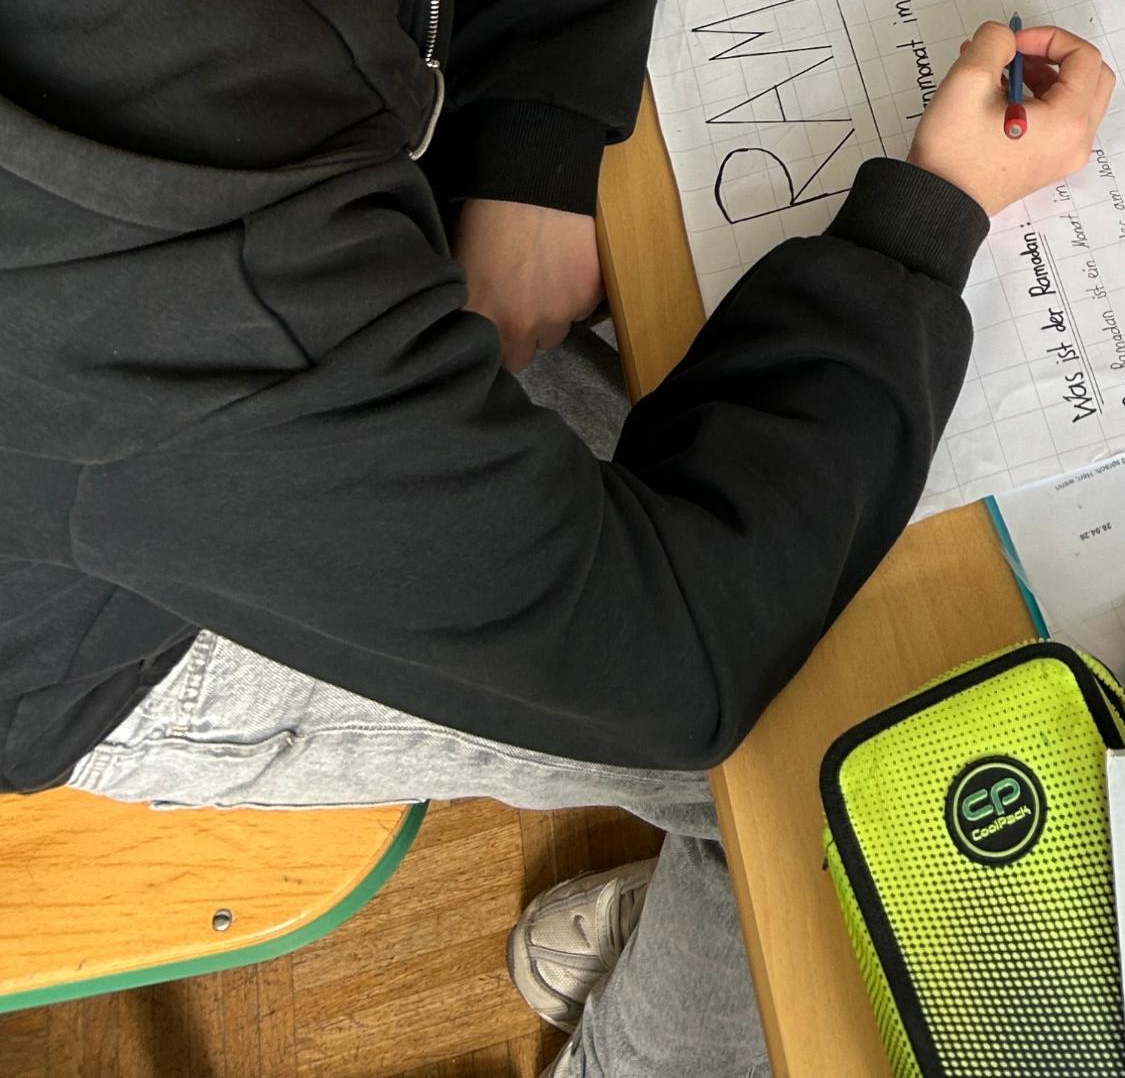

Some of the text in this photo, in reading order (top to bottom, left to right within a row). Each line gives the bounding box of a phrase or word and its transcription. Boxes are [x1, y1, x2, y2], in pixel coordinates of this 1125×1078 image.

[893, 0, 918, 25] im
[896, 40, 939, 119] nmonat
[1090, 149, 1115, 178] Mond
[1109, 190, 1125, 210] am
[1059, 214, 1090, 248] Monat
[1082, 260, 1099, 279] ein
[1085, 285, 1107, 300] ist
[1020, 222, 1097, 422] Was ist der Ramadan:
[971, 804, 1031, 842] CoolPack
